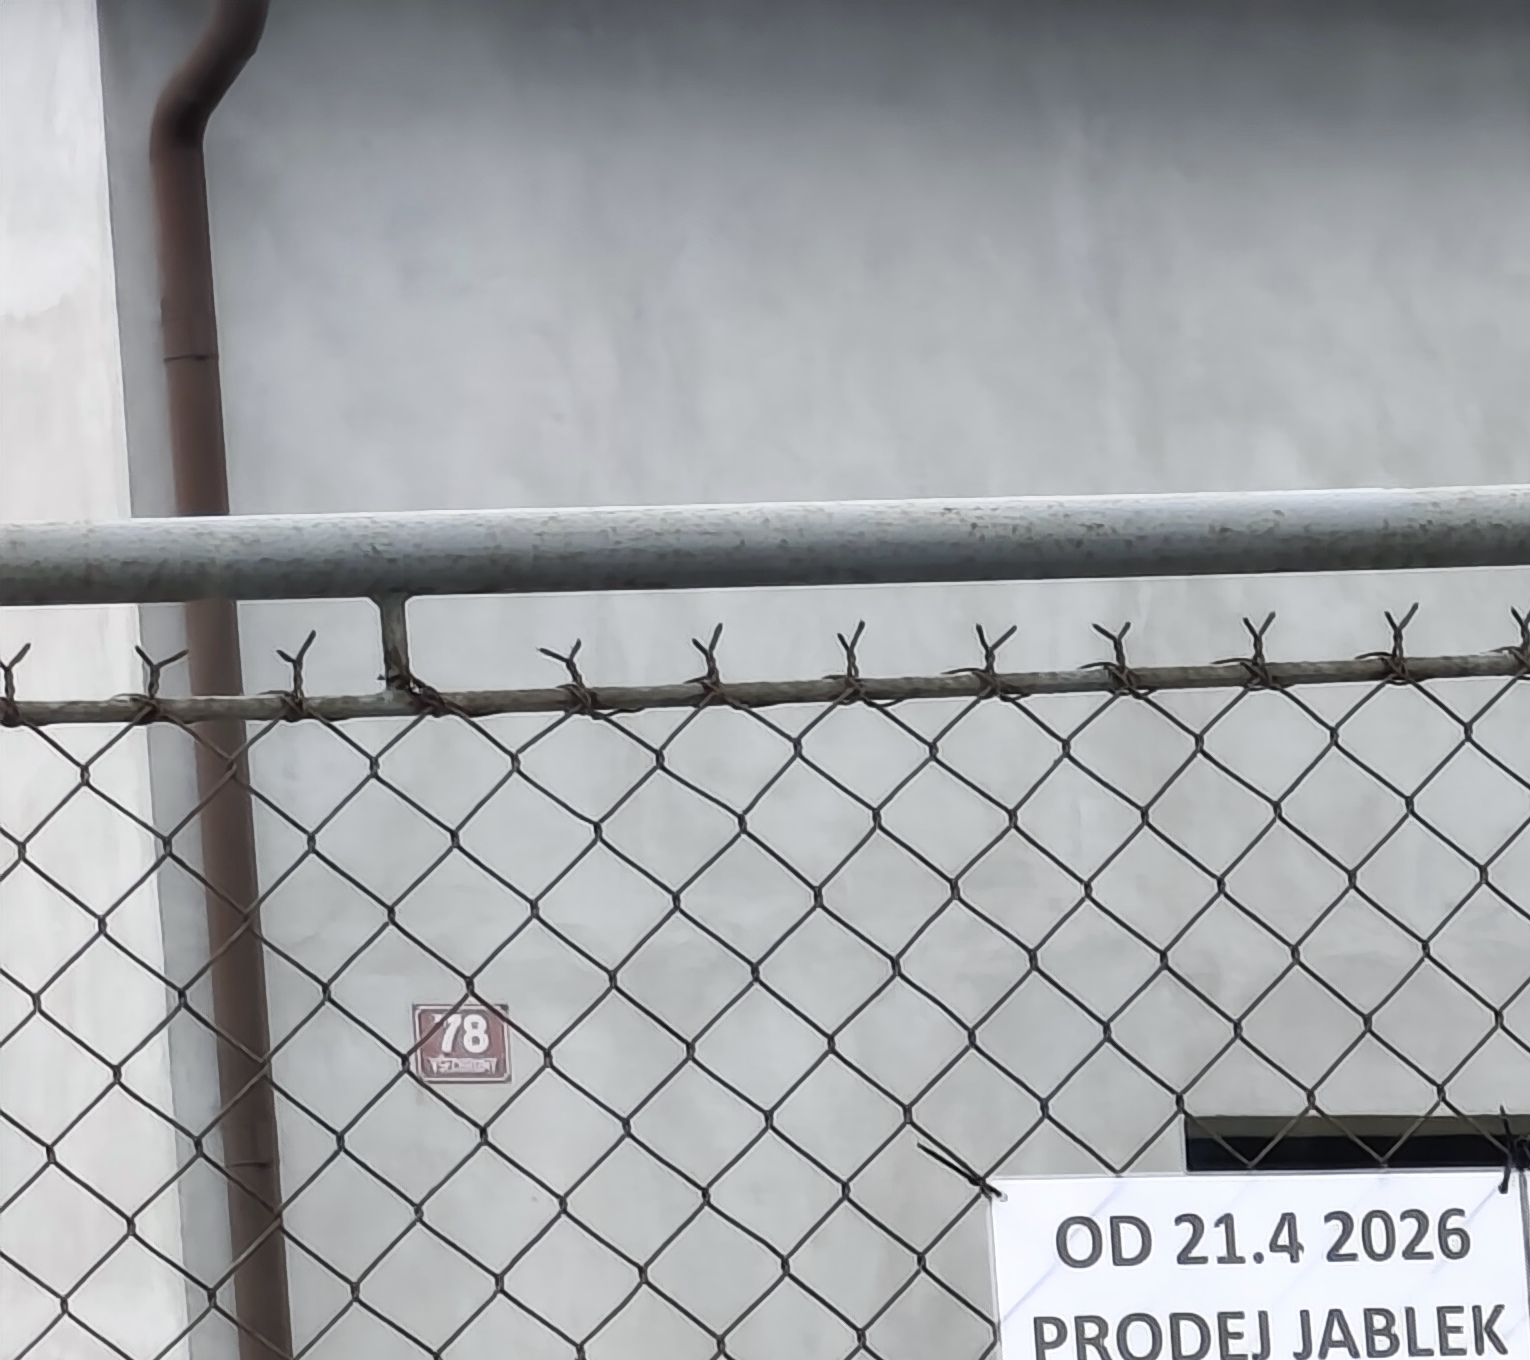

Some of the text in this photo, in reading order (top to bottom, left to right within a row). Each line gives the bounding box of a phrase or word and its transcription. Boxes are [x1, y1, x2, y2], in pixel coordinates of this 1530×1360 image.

[431, 1013, 489, 1053] 78
[1055, 1208, 1471, 1268] OD 21.4 2026
[1292, 1304, 1509, 1360] JABLEK
